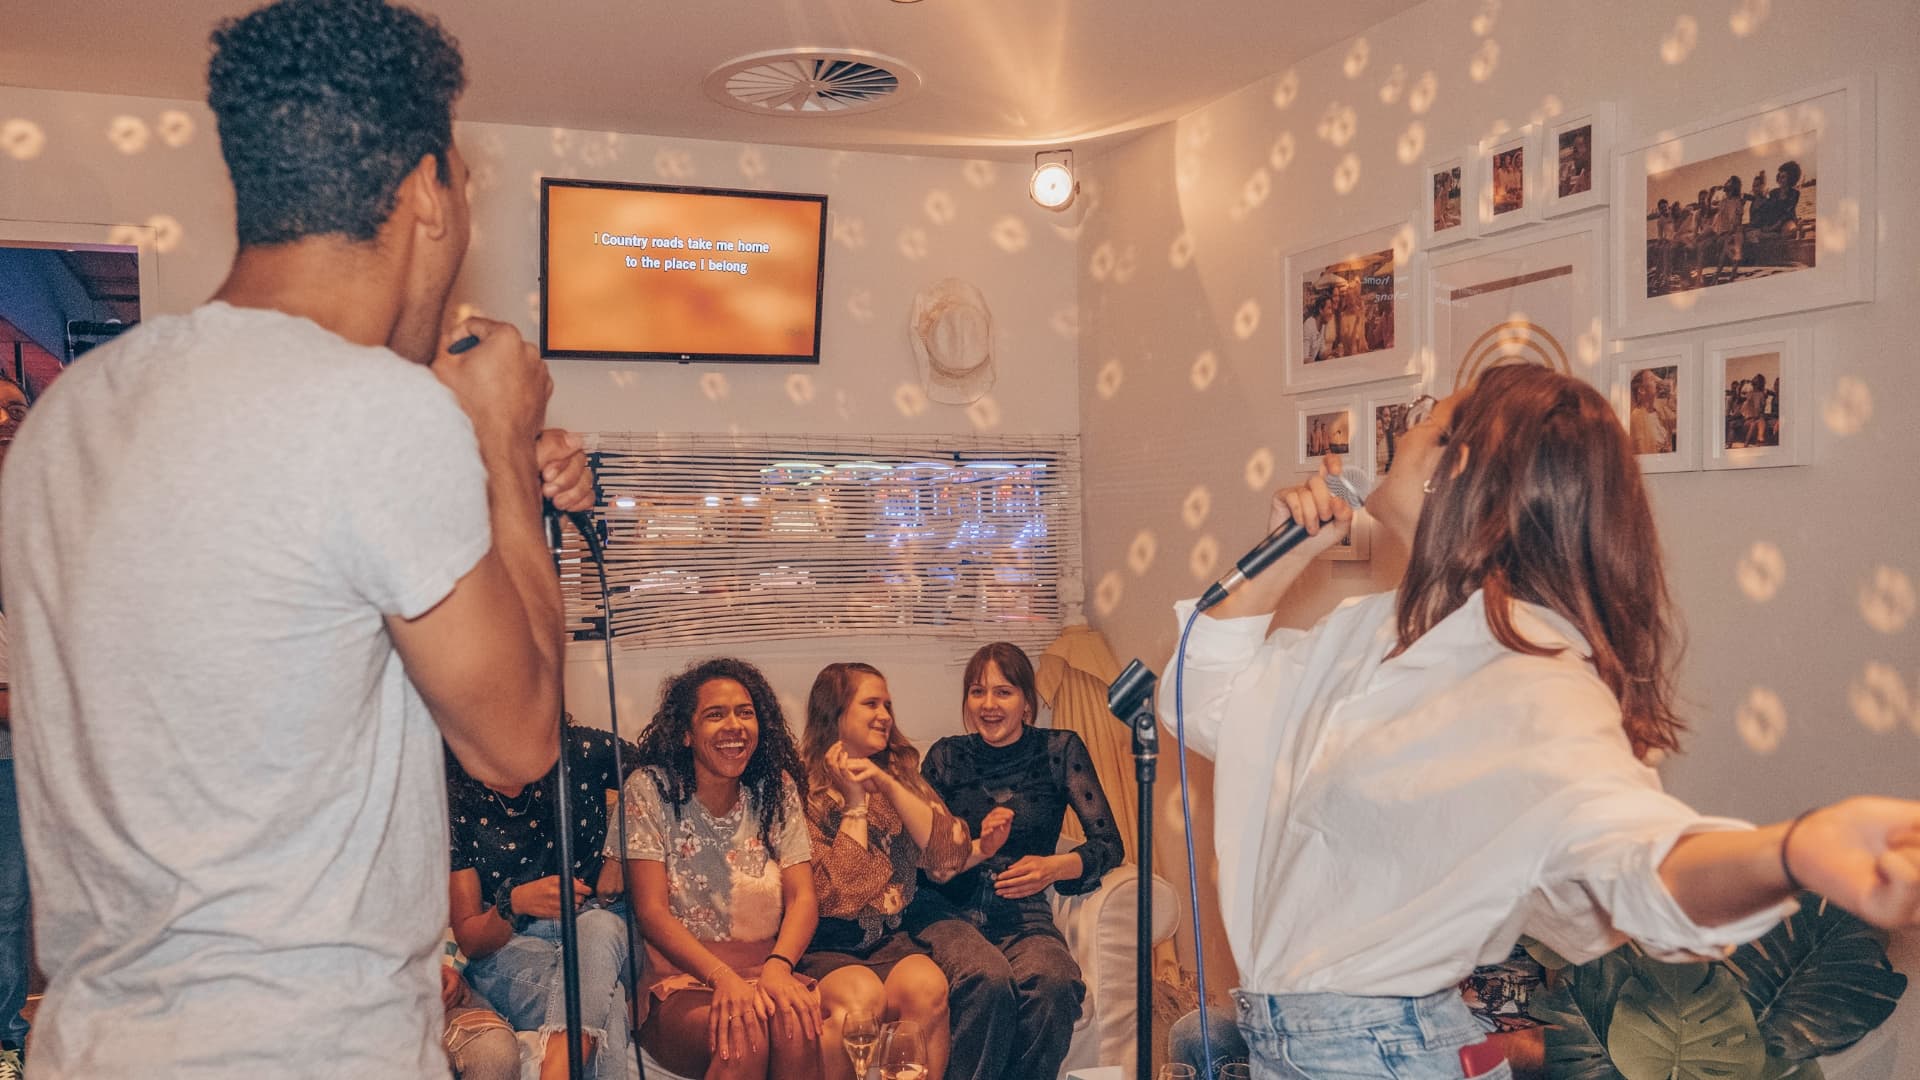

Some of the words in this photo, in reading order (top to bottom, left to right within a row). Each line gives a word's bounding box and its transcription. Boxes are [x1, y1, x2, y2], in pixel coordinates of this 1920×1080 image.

[601, 232, 649, 250] Country
[651, 235, 684, 249] roads
[687, 236, 713, 250] take
[716, 239, 734, 251] me
[738, 238, 770, 253] home
[625, 254, 638, 268] to
[641, 255, 660, 269] the
[664, 256, 697, 272] place
[699, 257, 705, 271] I
[708, 258, 748, 275] belong
